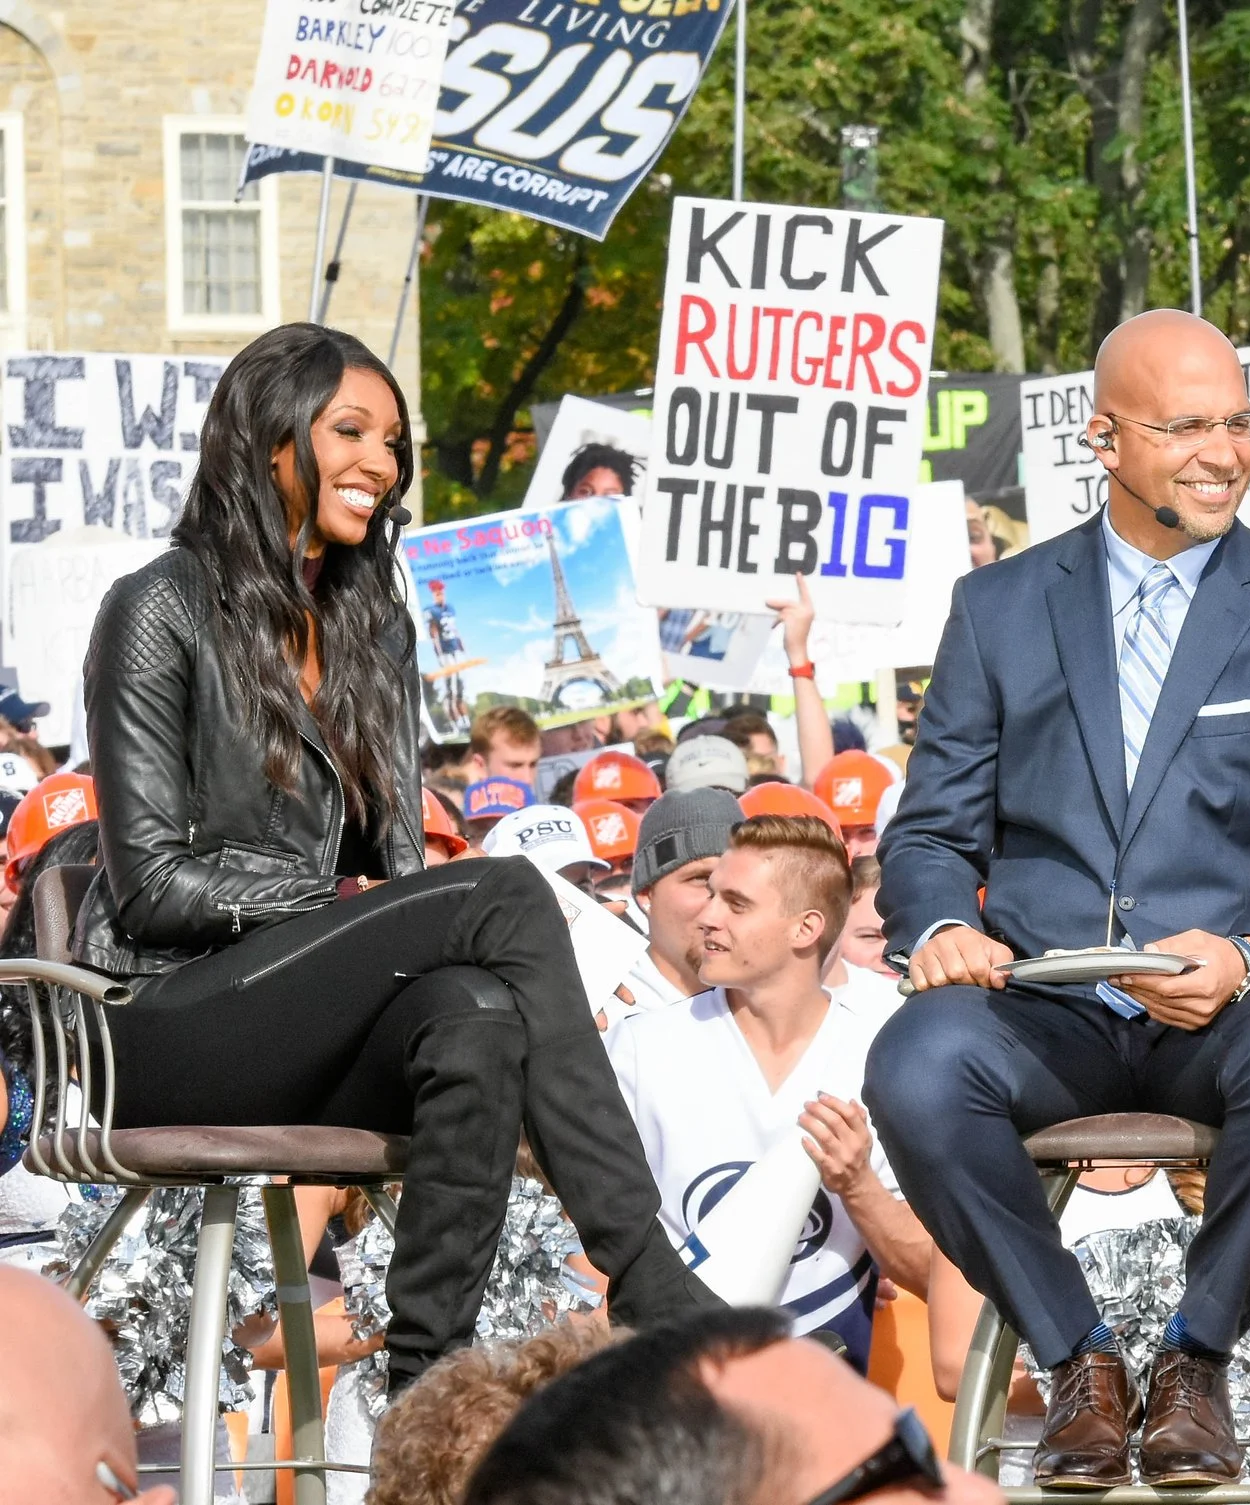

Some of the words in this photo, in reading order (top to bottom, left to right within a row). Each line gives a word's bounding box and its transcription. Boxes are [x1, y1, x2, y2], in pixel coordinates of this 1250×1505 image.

[295, 15, 386, 53] BARKLEY
[386, 29, 432, 59] 100
[518, 0, 671, 48] LIVING
[432, 15, 701, 182] SUS
[442, 154, 498, 183] ARE
[490, 165, 611, 214] CORRUPT
[685, 206, 904, 297] KICK
[673, 294, 926, 399] RUTGERS
[7, 356, 86, 449] I
[665, 386, 799, 475] OUT
[820, 400, 907, 480] OF
[10, 457, 63, 543] I
[456, 517, 552, 550] Saquon
[657, 477, 766, 574] THE
[516, 820, 572, 845] PSU
